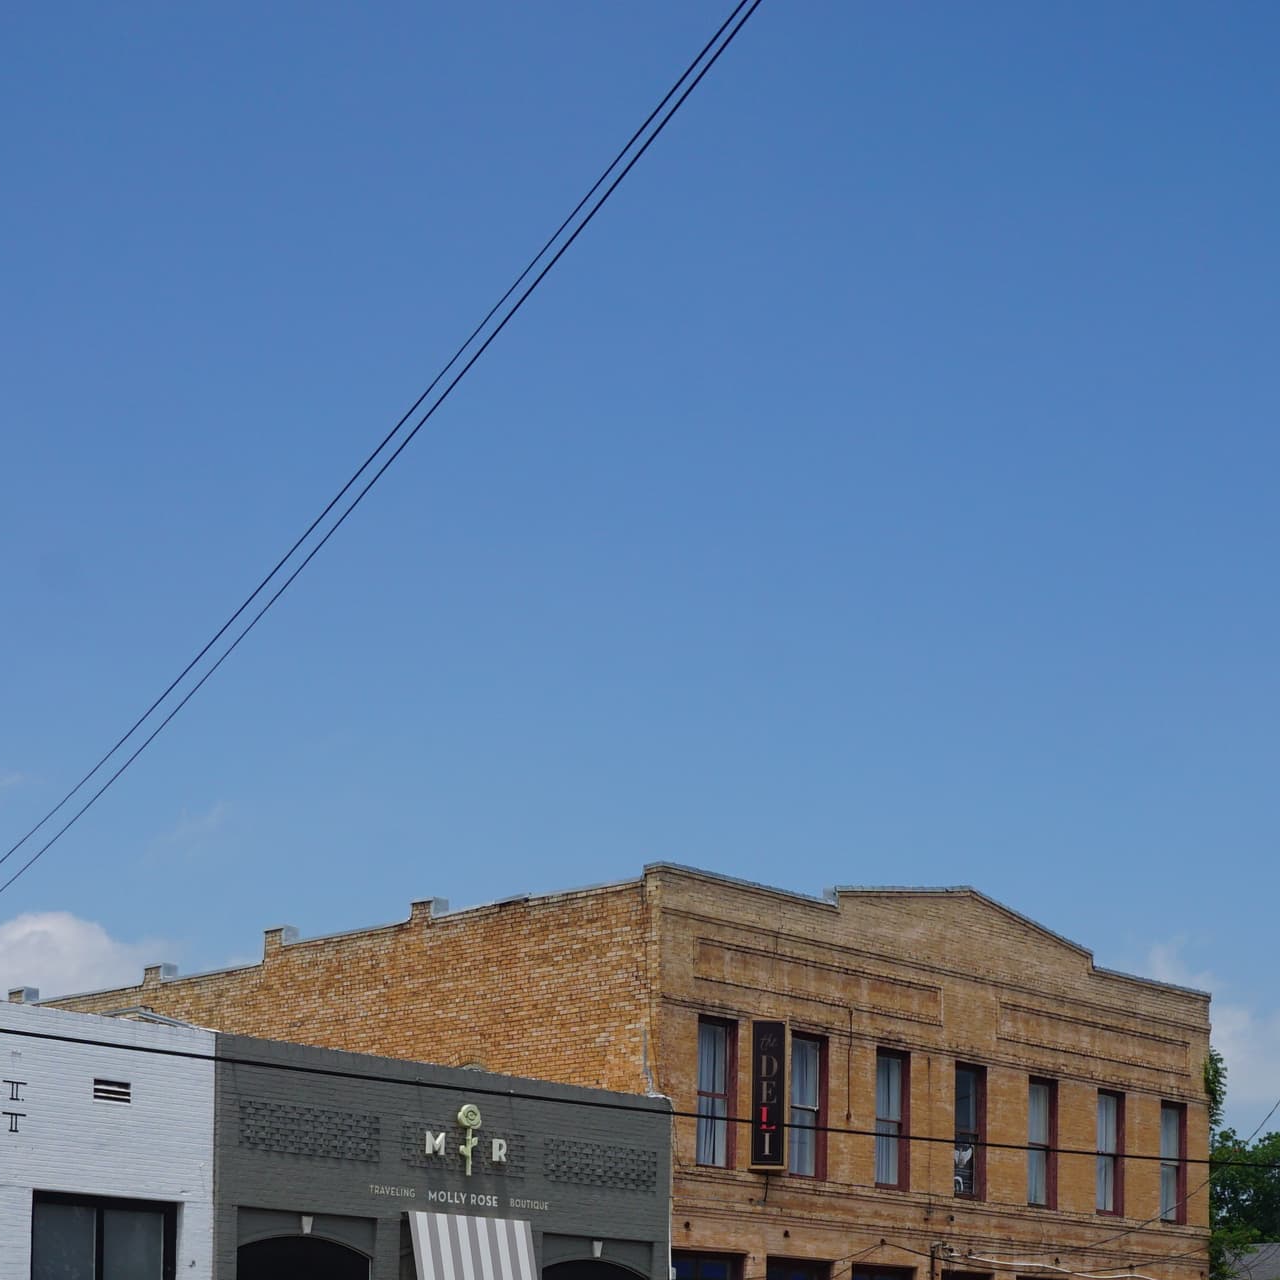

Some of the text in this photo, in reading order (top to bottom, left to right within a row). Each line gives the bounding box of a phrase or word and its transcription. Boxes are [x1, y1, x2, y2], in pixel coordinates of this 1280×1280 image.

[760, 1055, 778, 1156] DELI
[425, 1131, 507, 1162] M R
[369, 1184, 549, 1211] TRAVELING MOLLY ROSE BOUTIQUE
